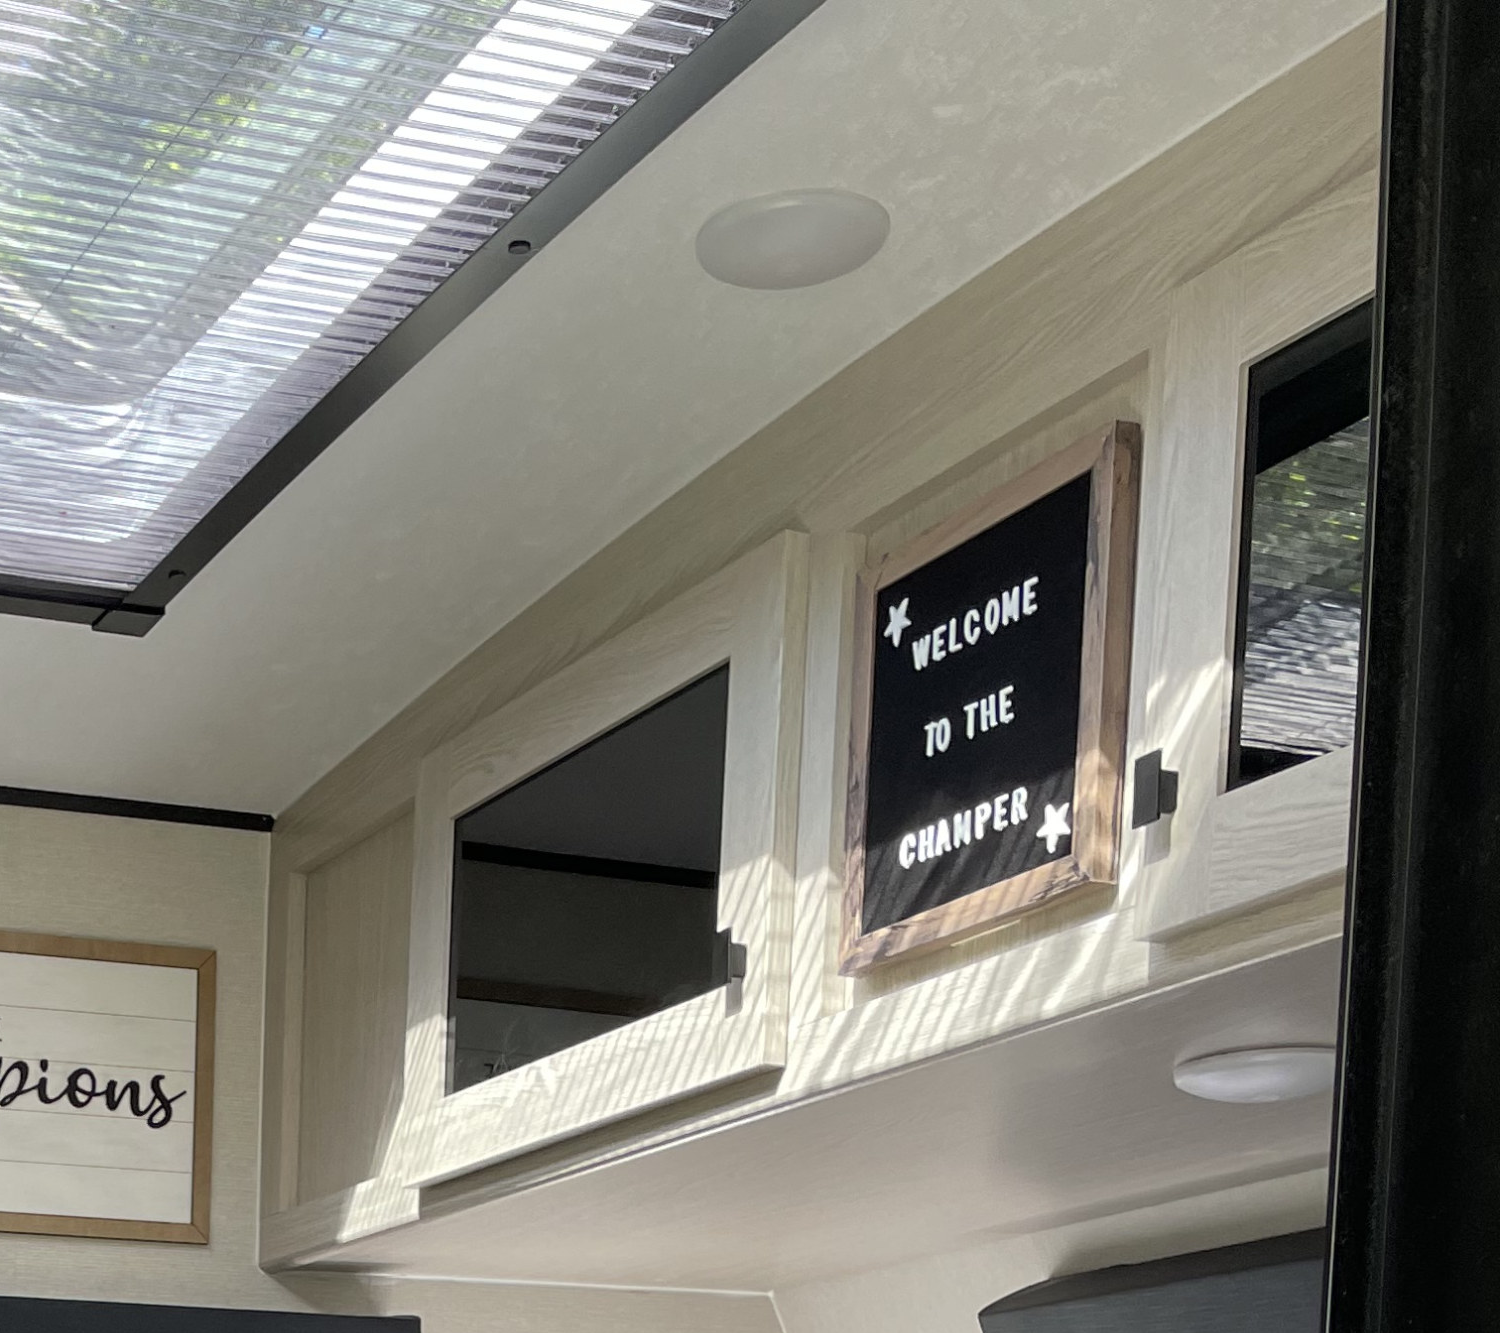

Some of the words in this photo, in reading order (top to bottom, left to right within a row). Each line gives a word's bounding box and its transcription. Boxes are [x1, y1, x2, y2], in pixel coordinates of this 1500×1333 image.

[912, 576, 1039, 670] WELCOME
[923, 717, 951, 757] TO
[963, 684, 1015, 740] THE
